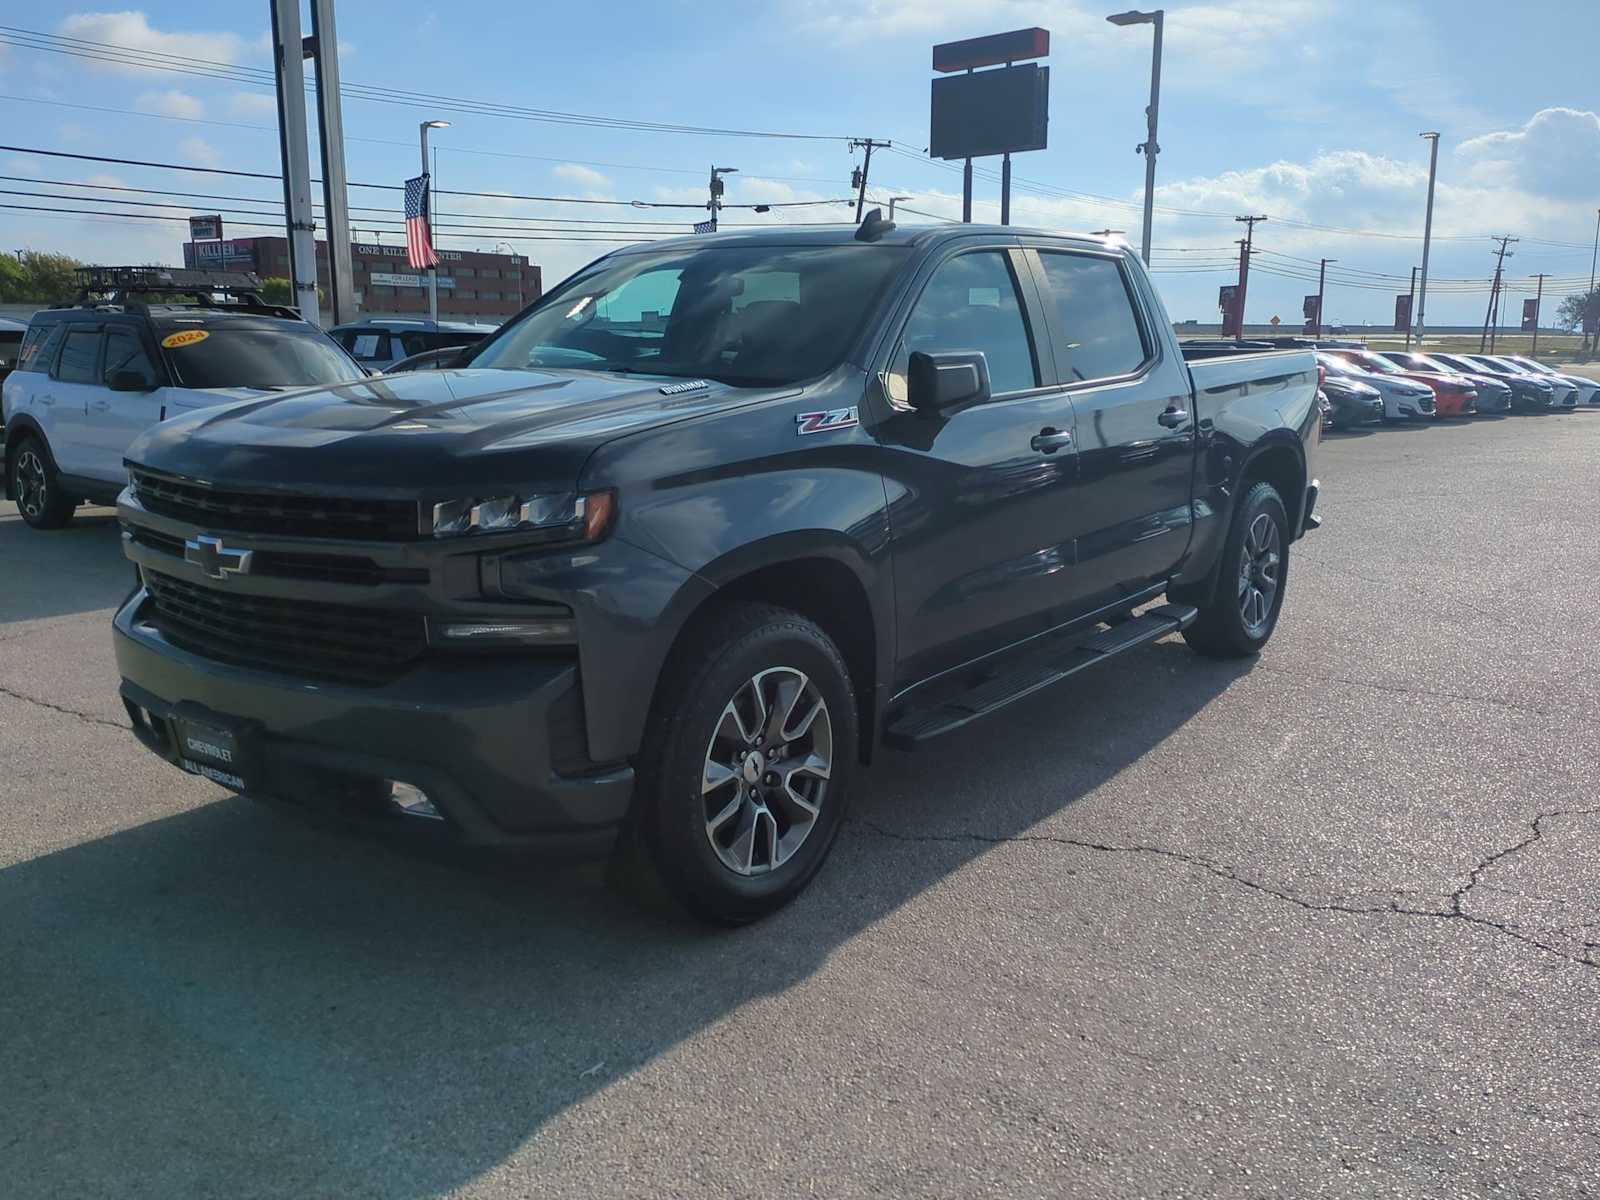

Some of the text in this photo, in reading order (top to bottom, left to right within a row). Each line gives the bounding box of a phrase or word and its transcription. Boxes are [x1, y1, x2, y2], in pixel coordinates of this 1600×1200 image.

[358, 245, 380, 255] ONE
[167, 330, 205, 346] 2024
[661, 380, 709, 394] DURAMAX
[796, 405, 860, 435] Z71
[186, 736, 233, 762] CHEVROLET
